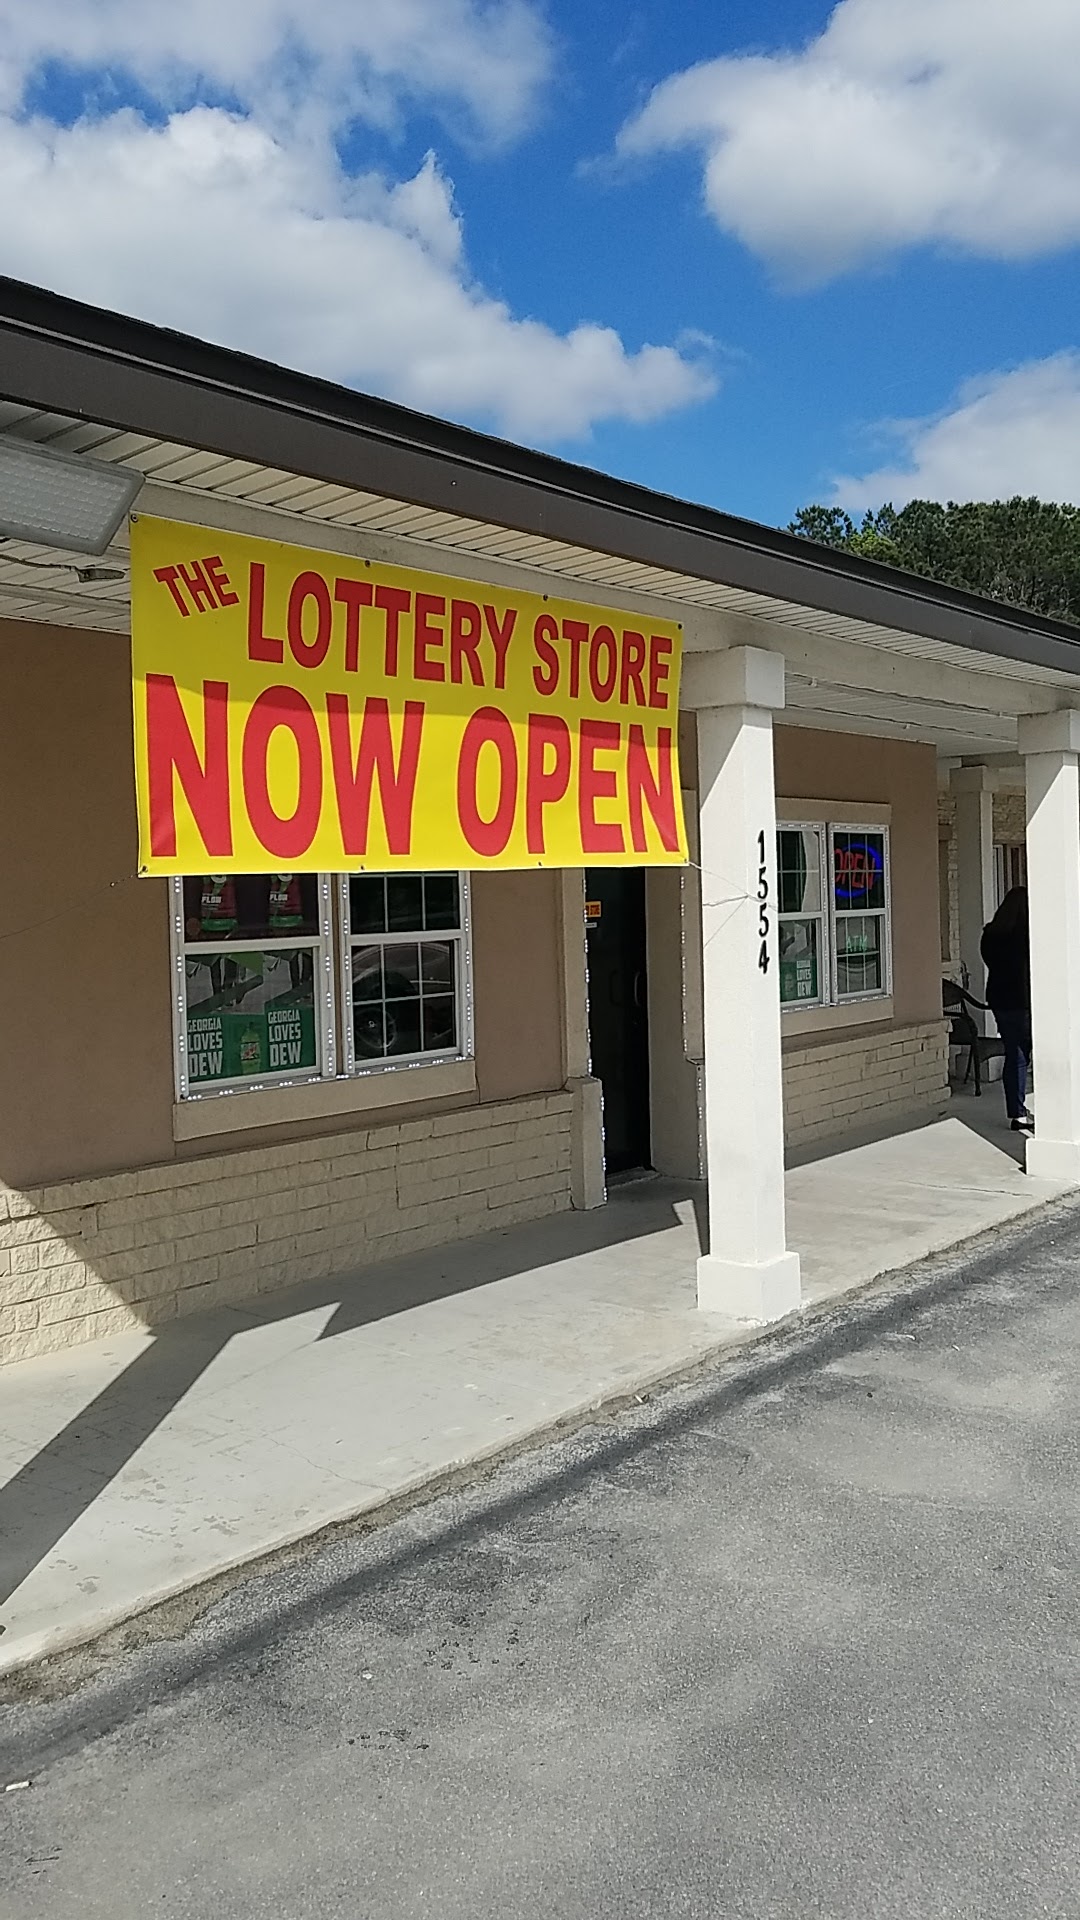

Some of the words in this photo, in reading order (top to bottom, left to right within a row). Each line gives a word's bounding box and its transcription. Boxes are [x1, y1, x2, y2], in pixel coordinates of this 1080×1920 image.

[152, 555, 239, 618] THE
[248, 561, 517, 689] LOTTERY
[532, 614, 672, 709] STORE
[145, 673, 425, 857] NOW
[457, 705, 680, 857] OPEN
[834, 848, 876, 890] OPEN
[757, 829, 770, 974] 1554
[846, 935, 868, 952] ATM
[187, 1017, 222, 1032] GEORGIA
[268, 1009, 301, 1024] GEORGIA
[188, 1032, 223, 1051] LOVES
[269, 1023, 301, 1042] LOVES
[188, 1051, 223, 1077] DEW
[269, 1041, 302, 1067] DEW
